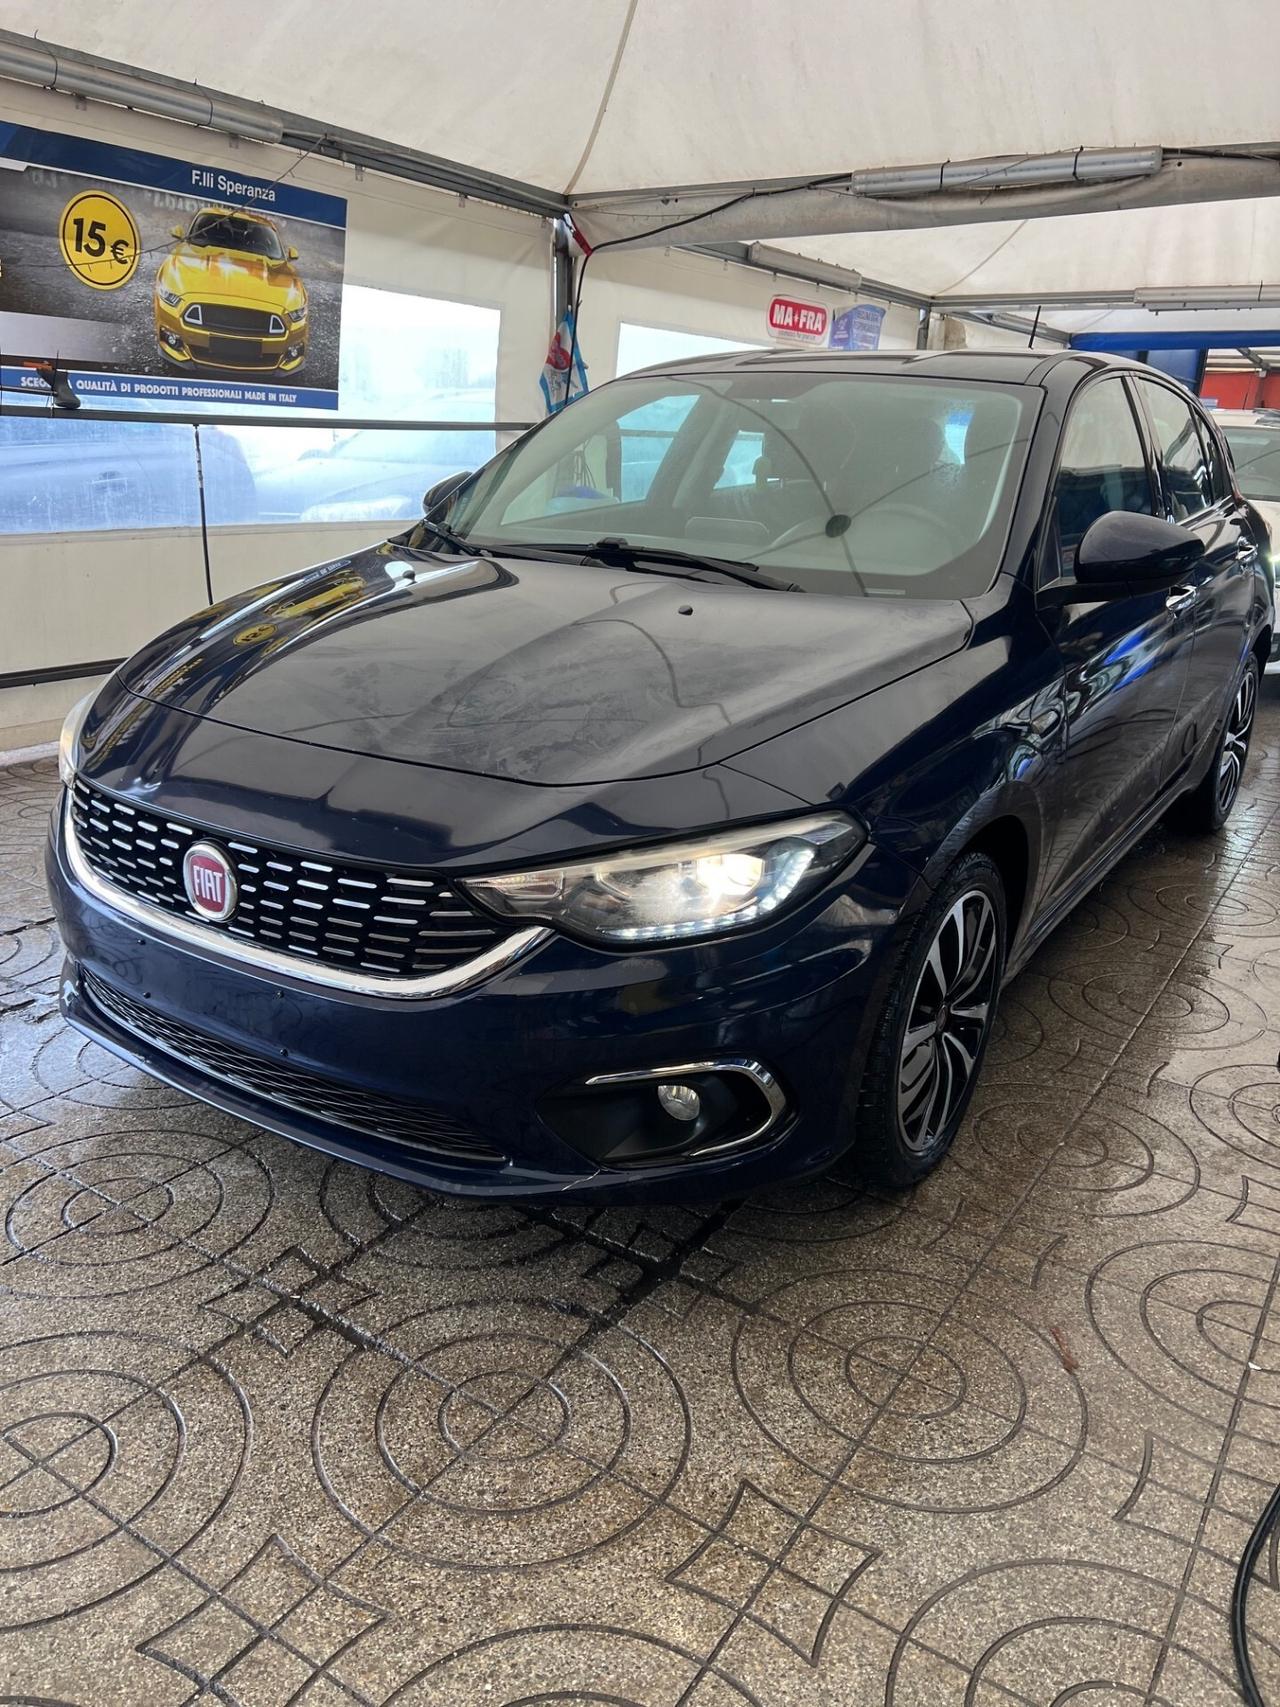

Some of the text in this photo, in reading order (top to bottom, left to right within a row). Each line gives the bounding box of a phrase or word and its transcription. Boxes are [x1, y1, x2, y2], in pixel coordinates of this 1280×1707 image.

[217, 175, 276, 202] Speranza
[76, 379, 118, 392] QUALITÀ
[121, 382, 131, 393] DI
[134, 383, 179, 396] PRODOTTI
[181, 386, 242, 399] PROFESSIONALI
[244, 391, 266, 401] MADE
[268, 392, 277, 402] IN
[278, 393, 297, 403] ITALY
[193, 865, 223, 903] FIAT
